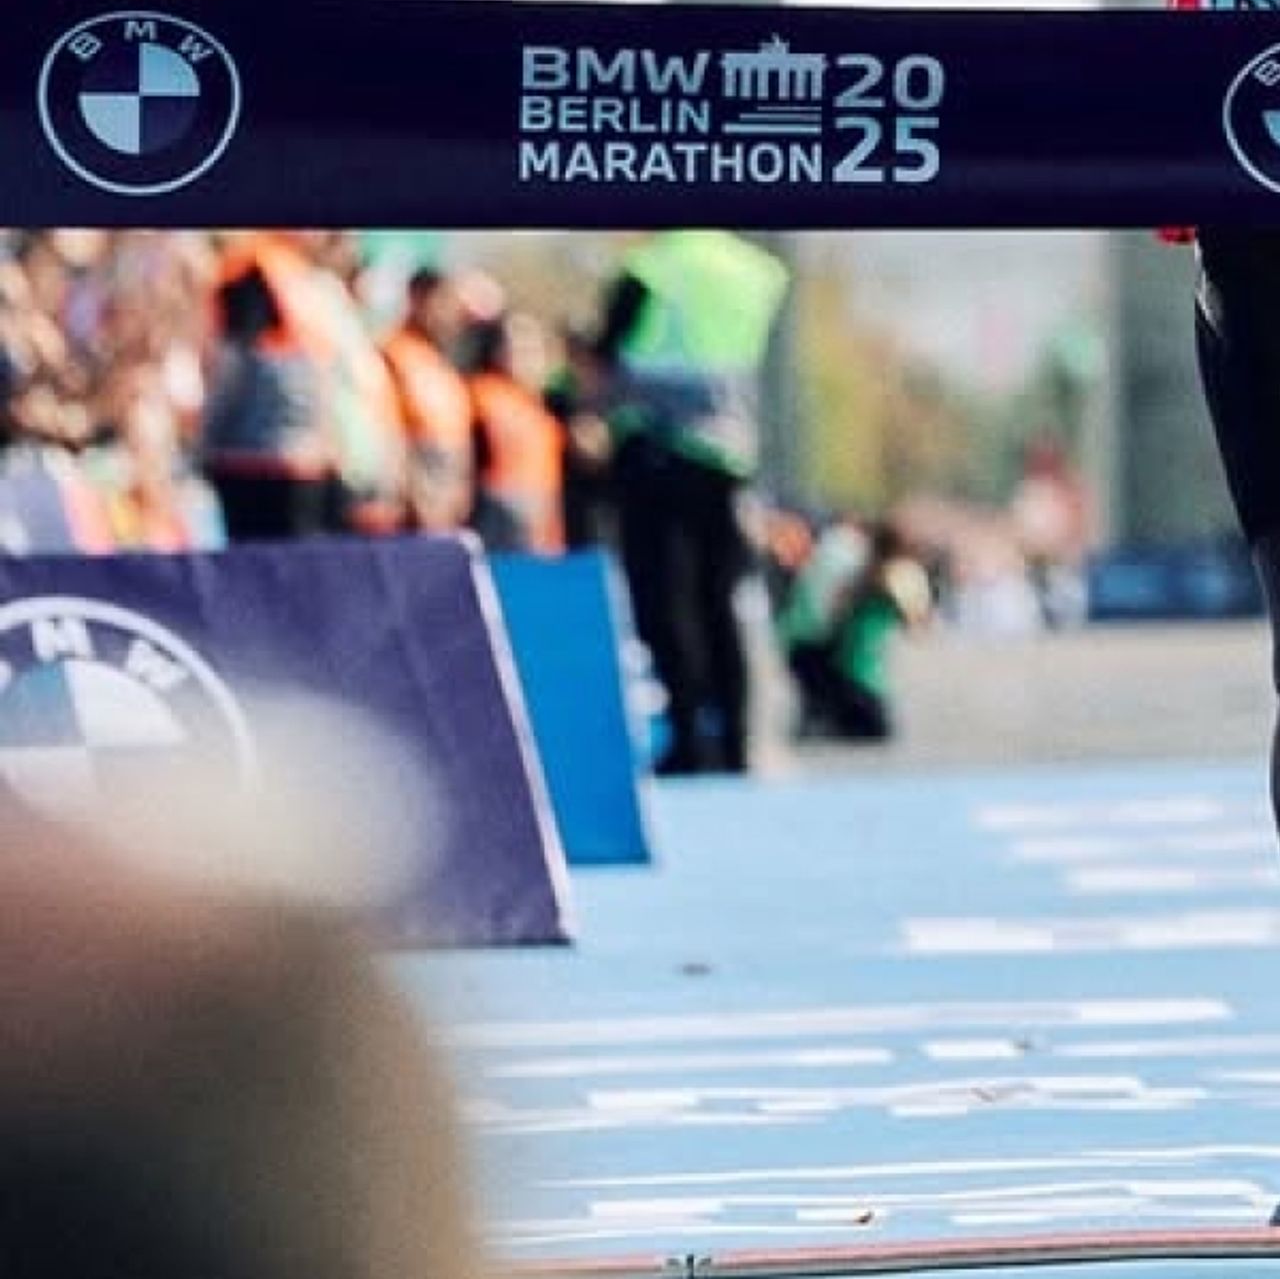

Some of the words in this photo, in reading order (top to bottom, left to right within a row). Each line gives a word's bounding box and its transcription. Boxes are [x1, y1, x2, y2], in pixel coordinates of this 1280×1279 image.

[68, 20, 212, 62] BMW
[521, 46, 710, 93] BMW
[834, 54, 944, 107] 20
[520, 97, 710, 133] BERLIN
[519, 142, 822, 182] MARATHON
[832, 117, 940, 183] 25
